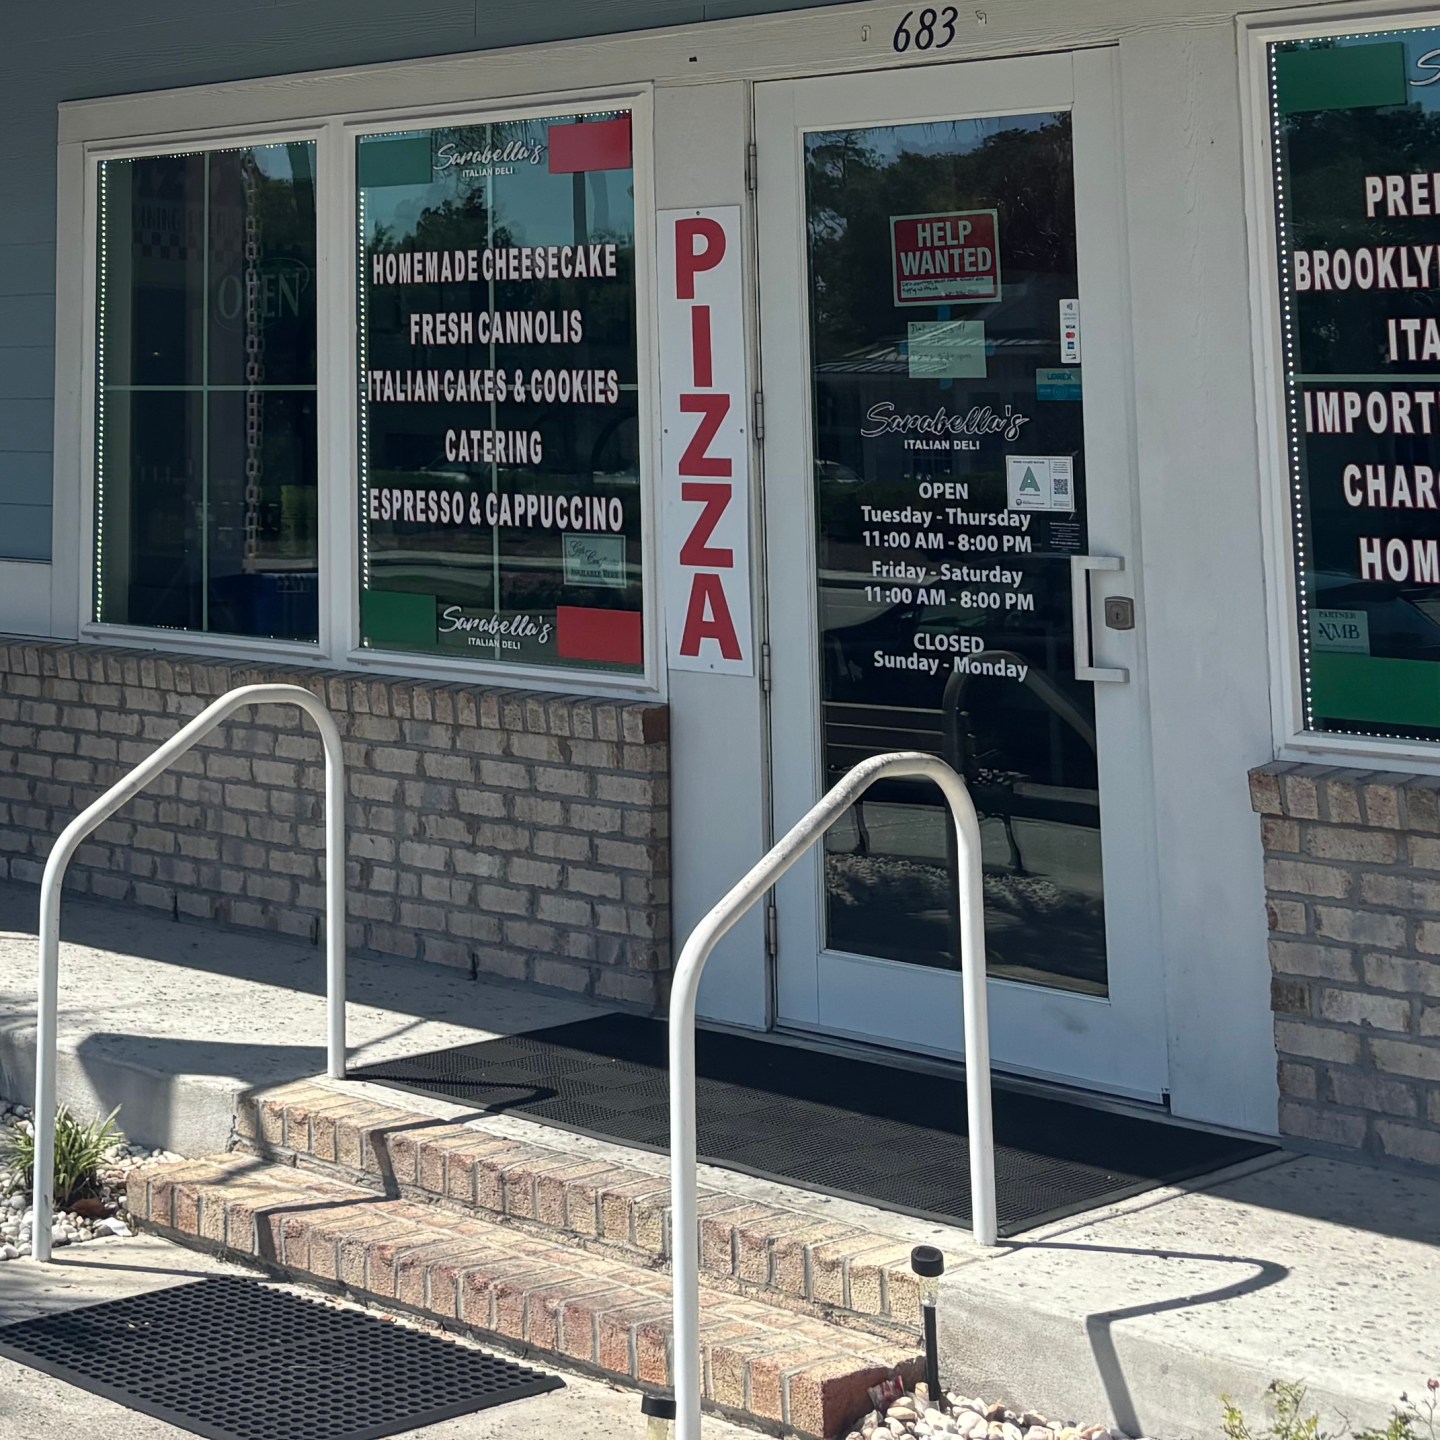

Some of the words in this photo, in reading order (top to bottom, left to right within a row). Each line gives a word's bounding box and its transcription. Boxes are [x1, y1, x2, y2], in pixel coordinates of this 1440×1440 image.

[893, 6, 958, 52] 683
[433, 139, 545, 170] Sarabella's
[462, 167, 493, 178] ITALIAN
[495, 166, 513, 176] DELI
[917, 220, 972, 248] HELP
[373, 249, 478, 285] HOMEMADE
[482, 244, 617, 282] CHEESECAKE
[900, 247, 992, 276] WANTED
[1294, 245, 1440, 291] BROOKLY
[410, 311, 473, 345] FRESH
[478, 310, 582, 345] CANNOLIS
[367, 369, 439, 402] ITALIAN
[444, 369, 507, 402] CAKES
[513, 369, 525, 403] &
[530, 369, 619, 404] COOKIES
[861, 402, 1030, 442] Sarabella's
[1304, 391, 1440, 434] IMPORT
[445, 429, 543, 464] CATERING
[675, 217, 743, 660] PIZZA
[904, 439, 950, 450] ITALIAN
[953, 440, 980, 450] DELI
[919, 482, 969, 500] OPEN
[1020, 465, 1040, 492] A
[1343, 463, 1440, 509] CHAR
[370, 488, 464, 525] ESPRESSO
[469, 491, 482, 527] &
[485, 492, 623, 532] CAPPUCCINO
[861, 505, 933, 528] Tuesday
[945, 508, 1031, 531] Thursday
[863, 530, 911, 549] 11:00
[915, 532, 944, 549] AM
[958, 534, 998, 552] 8:00
[1003, 535, 1032, 553] PM
[872, 560, 926, 583] Friday
[941, 563, 1023, 588] Saturday
[864, 586, 912, 604] 11:00
[916, 588, 946, 606] AM
[960, 591, 1000, 609] 8:00
[1005, 593, 1034, 611] PM
[438, 605, 553, 643] Sarabella's
[468, 636, 500, 648] ITALIAN
[502, 639, 521, 650] DELI
[914, 633, 985, 654] CLOSED
[874, 650, 940, 675] Sunday
[954, 657, 1028, 682] Monday
